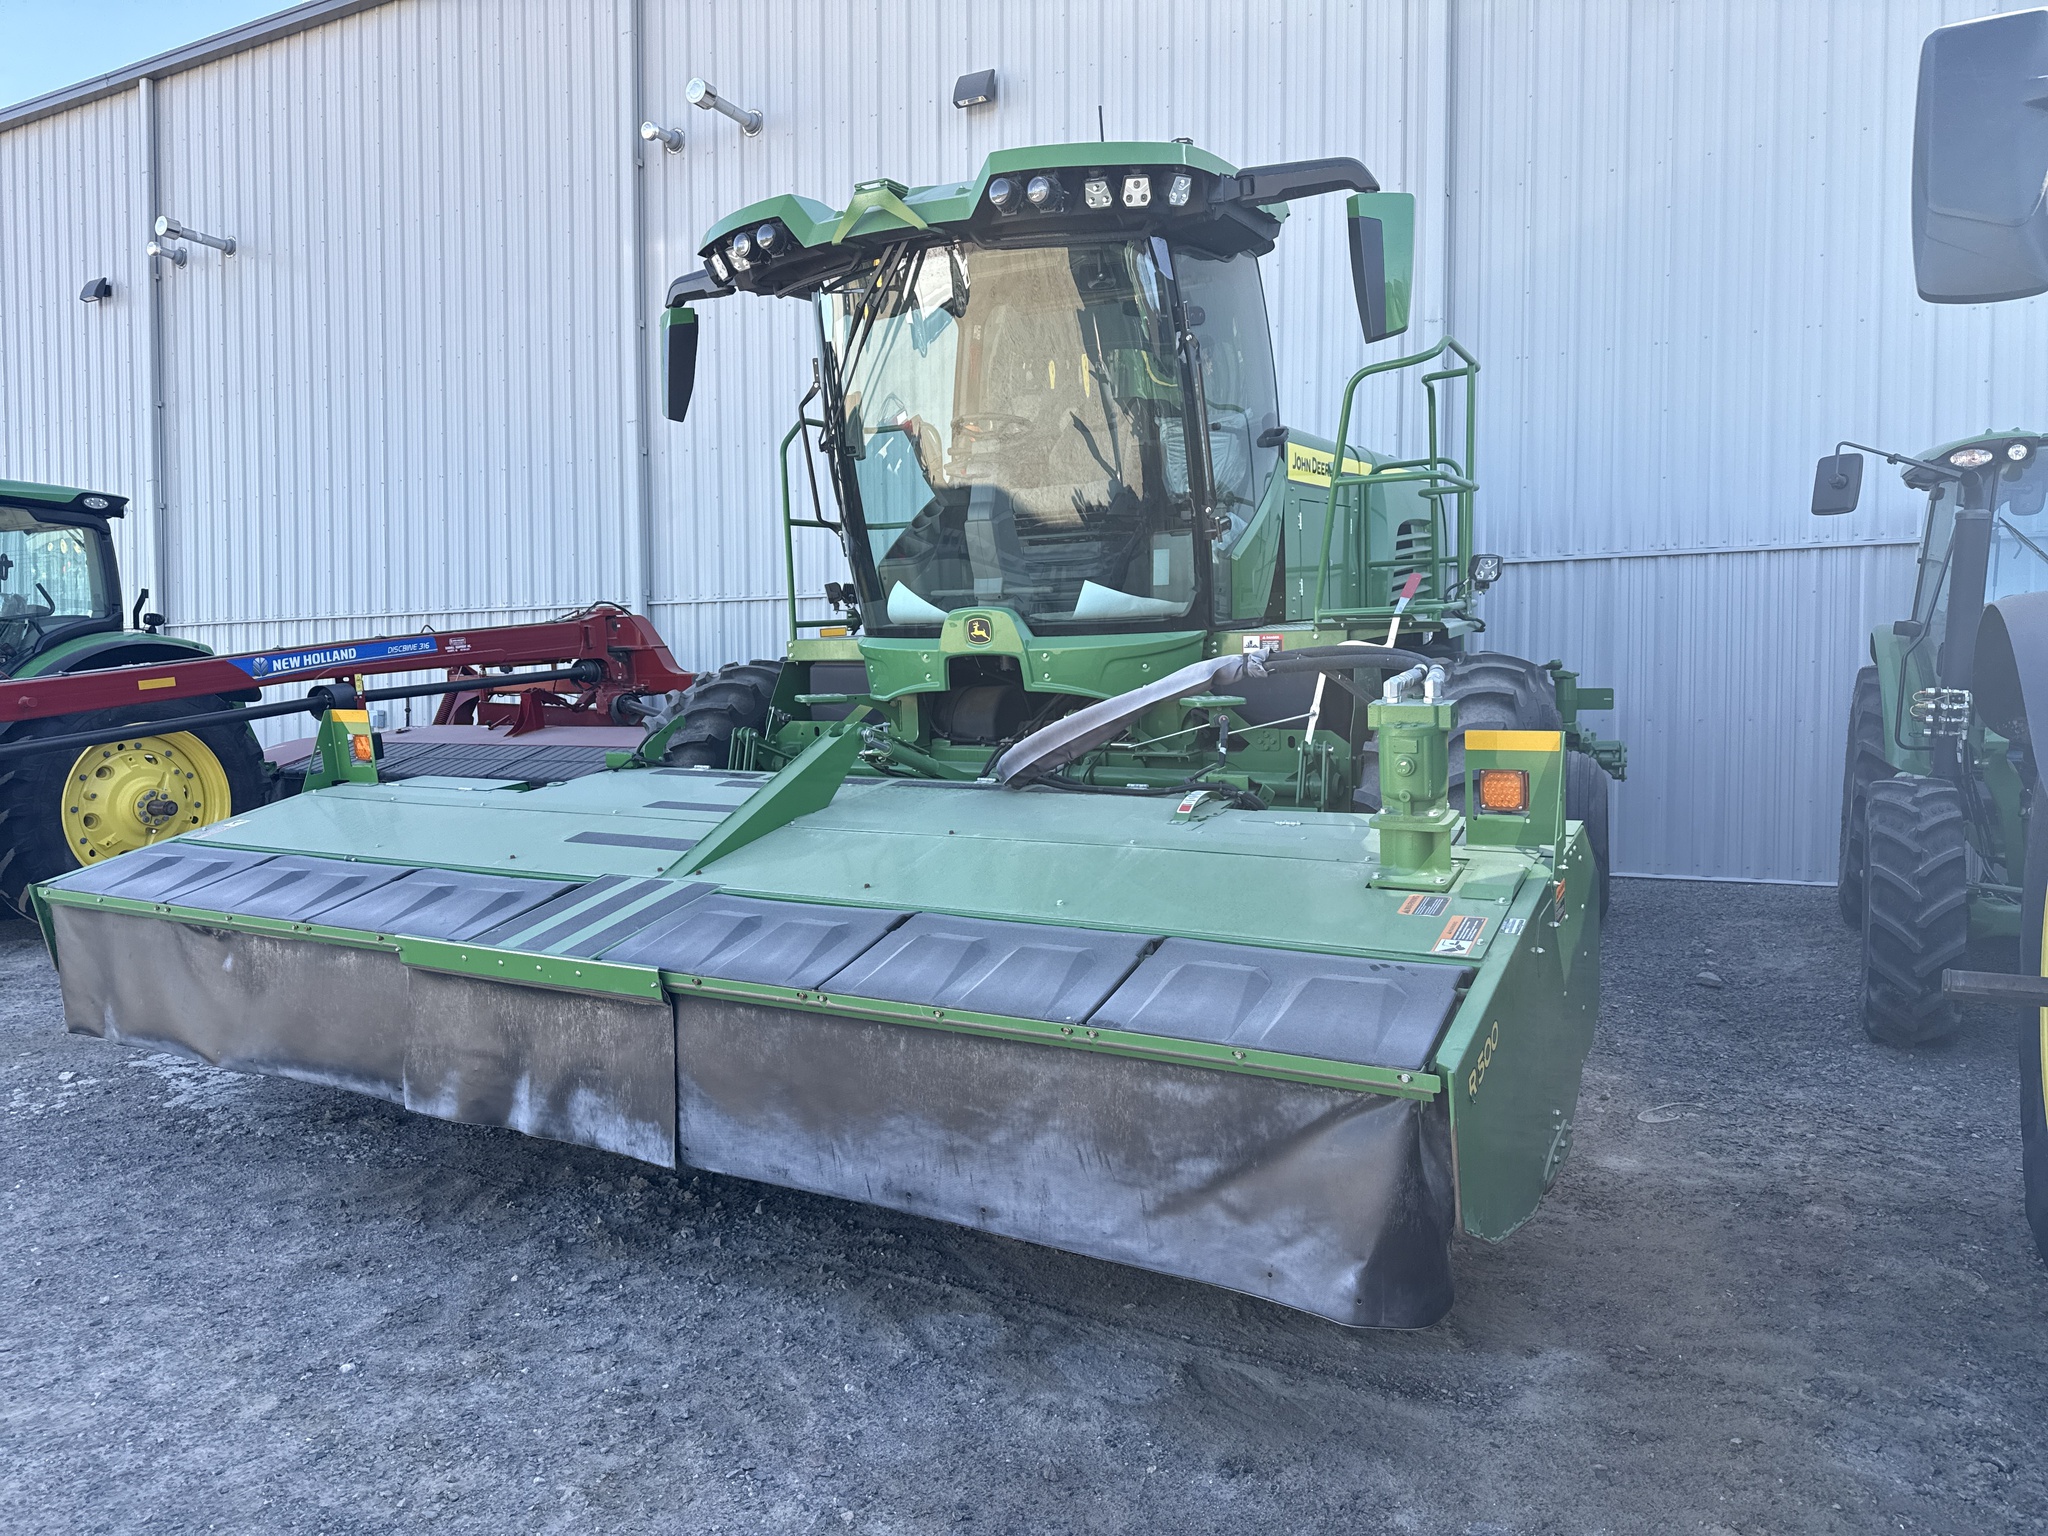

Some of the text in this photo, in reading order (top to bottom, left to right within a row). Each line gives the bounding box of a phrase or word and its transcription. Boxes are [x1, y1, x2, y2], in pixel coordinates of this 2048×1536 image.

[1292, 452, 1311, 473] JOHN
[387, 641, 430, 654] DISCBINE 316
[272, 648, 357, 671] NEW HOLLAND
[1468, 1020, 1499, 1097] R500
